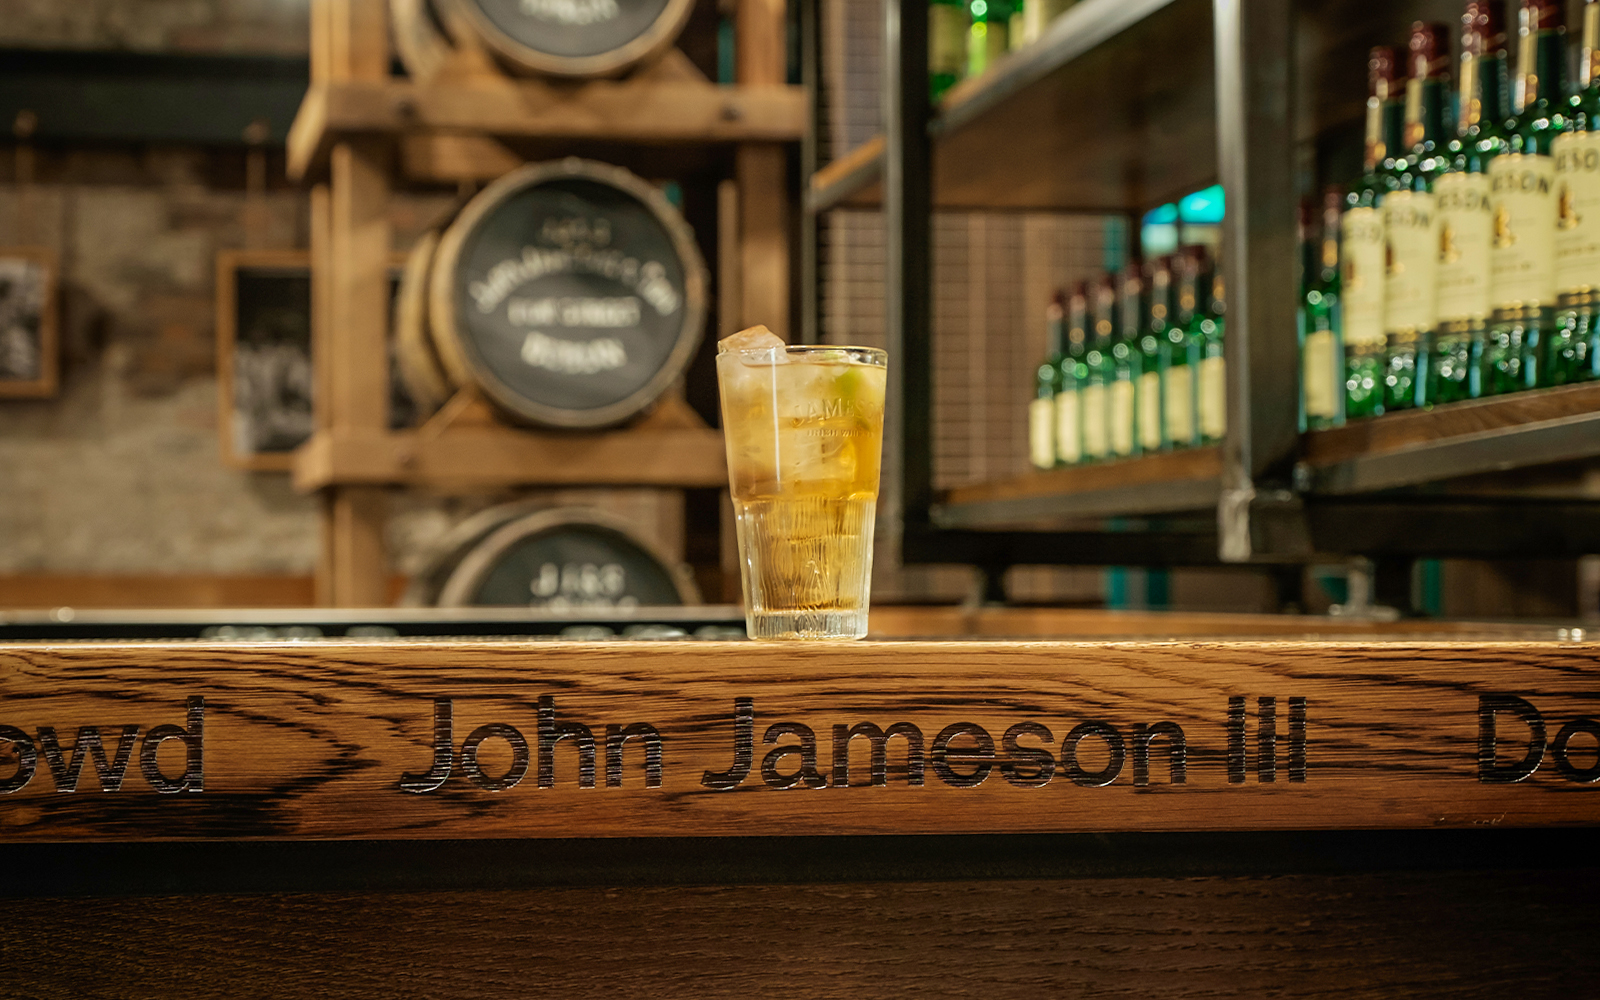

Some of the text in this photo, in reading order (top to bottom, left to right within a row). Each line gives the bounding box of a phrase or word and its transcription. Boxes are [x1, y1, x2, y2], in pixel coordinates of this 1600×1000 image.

[401, 697, 1307, 793] John Jameson III
[1478, 694, 1600, 786] Do
